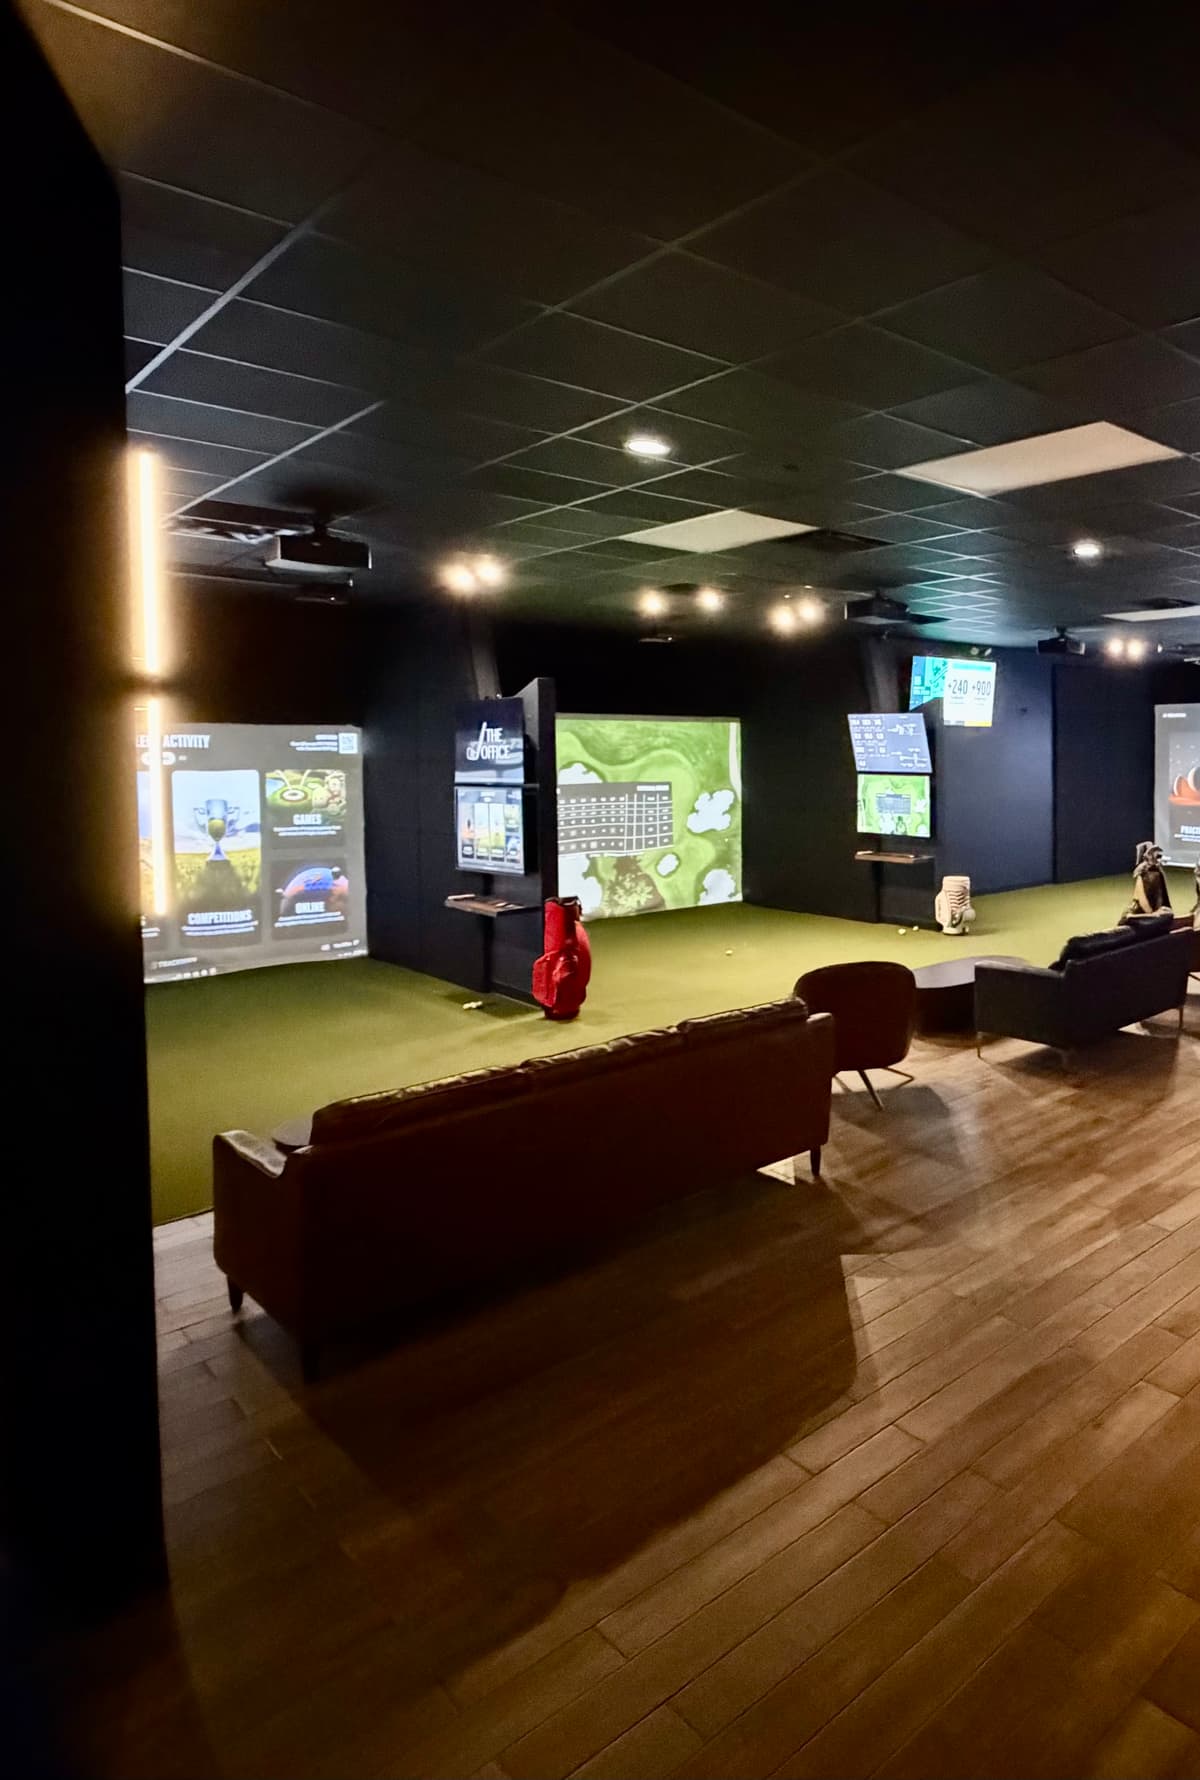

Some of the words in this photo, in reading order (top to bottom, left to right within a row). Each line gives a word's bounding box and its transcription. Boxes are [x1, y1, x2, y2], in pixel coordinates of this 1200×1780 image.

[948, 679, 968, 695] +240
[972, 680, 991, 697] +900
[163, 734, 210, 749] ACTIVITY
[486, 727, 503, 743] THE
[480, 744, 512, 760] OFFICE
